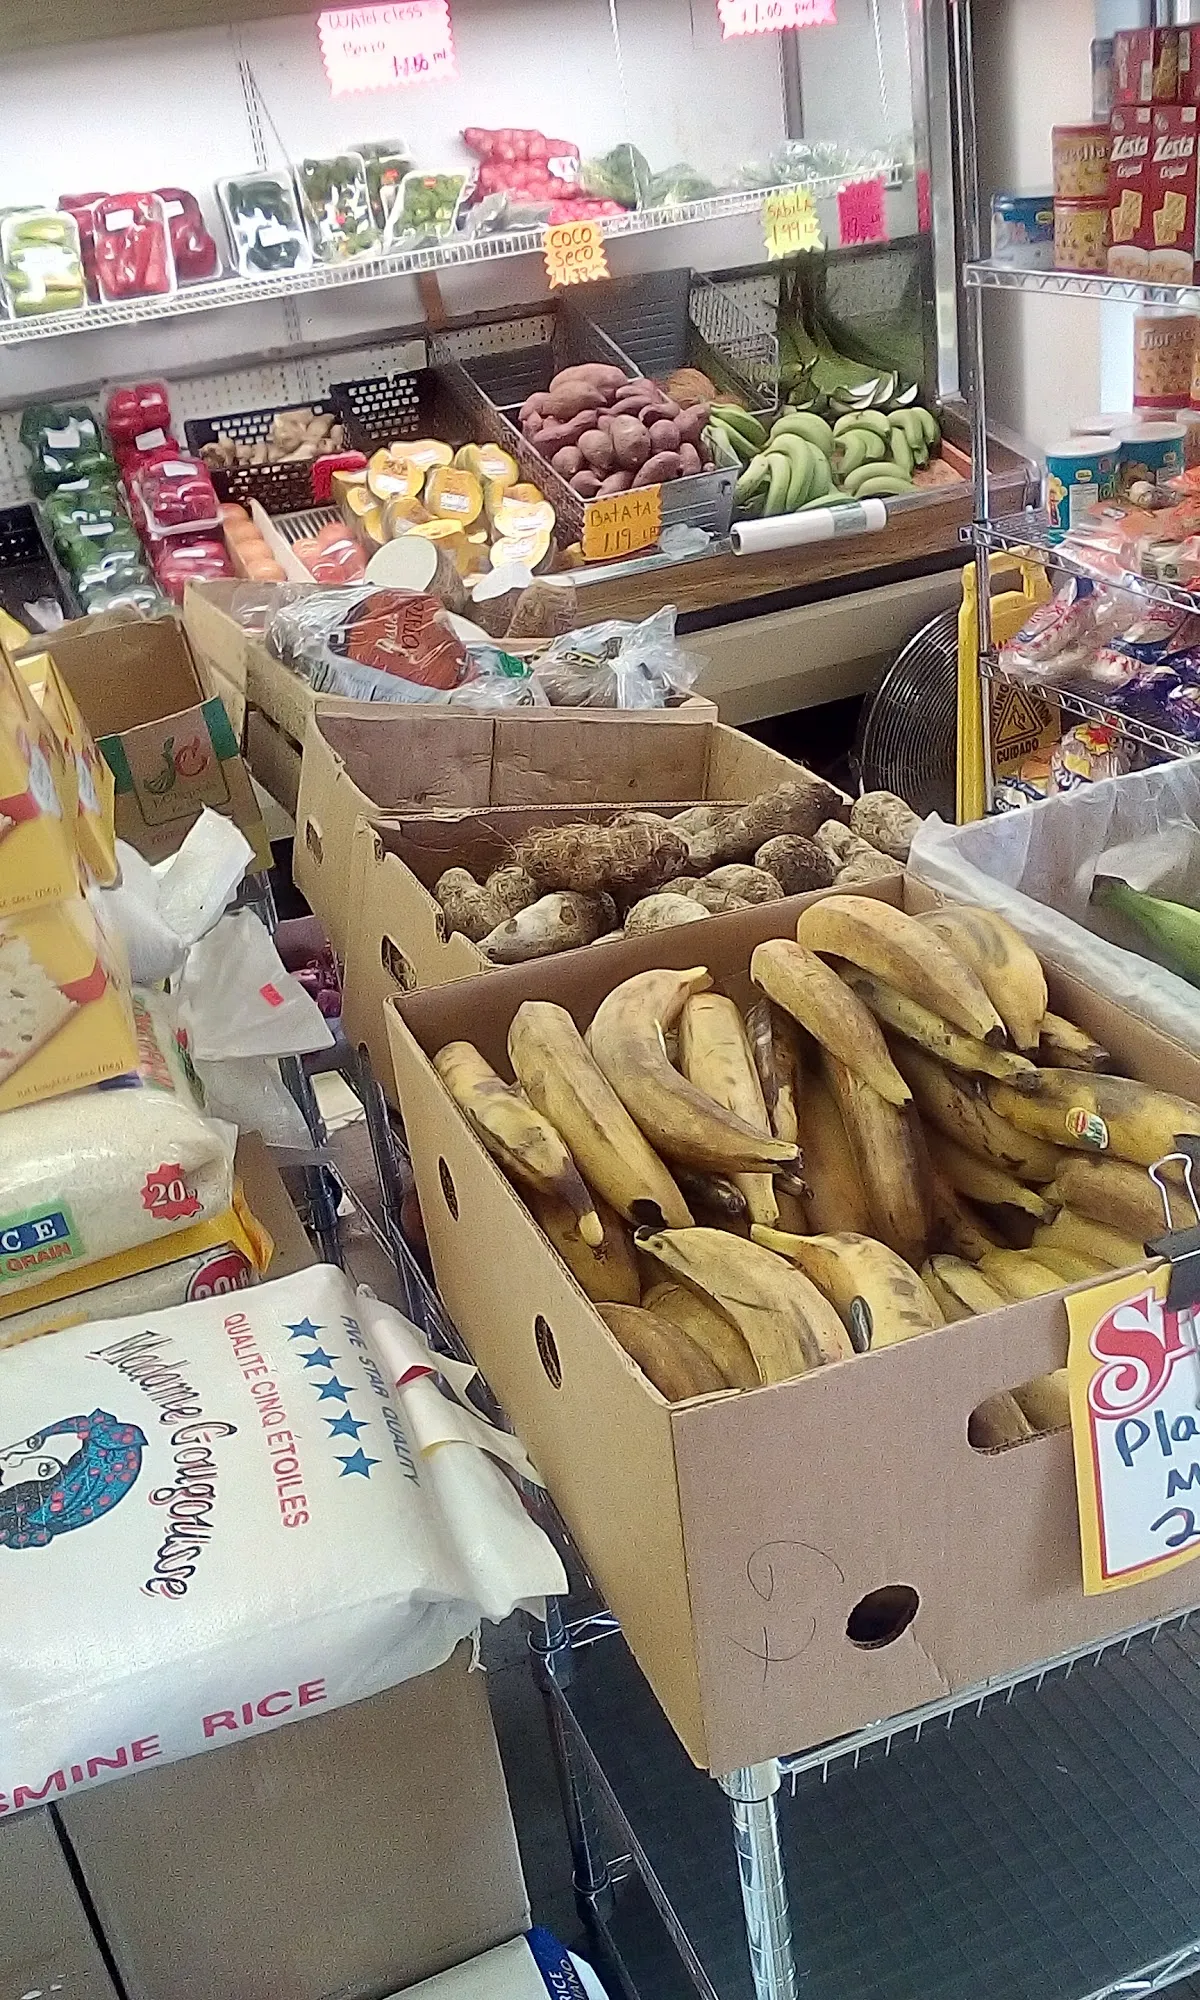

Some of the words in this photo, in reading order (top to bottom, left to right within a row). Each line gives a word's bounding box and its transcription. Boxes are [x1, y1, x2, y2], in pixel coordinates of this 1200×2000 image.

[1110, 136, 1149, 161] Zesta
[1152, 136, 1195, 162] Zesta
[604, 528, 632, 552] 1.19
[996, 738, 1039, 764] CUIDADO
[149, 1179, 186, 1207] 20
[86, 1330, 202, 1426] Madame
[250, 1380, 287, 1429] CINQ
[340, 1314, 367, 1351] FIVE
[358, 1355, 390, 1399] STAR
[381, 1405, 421, 1488] QUALITY
[202, 1678, 328, 1738] RICE
